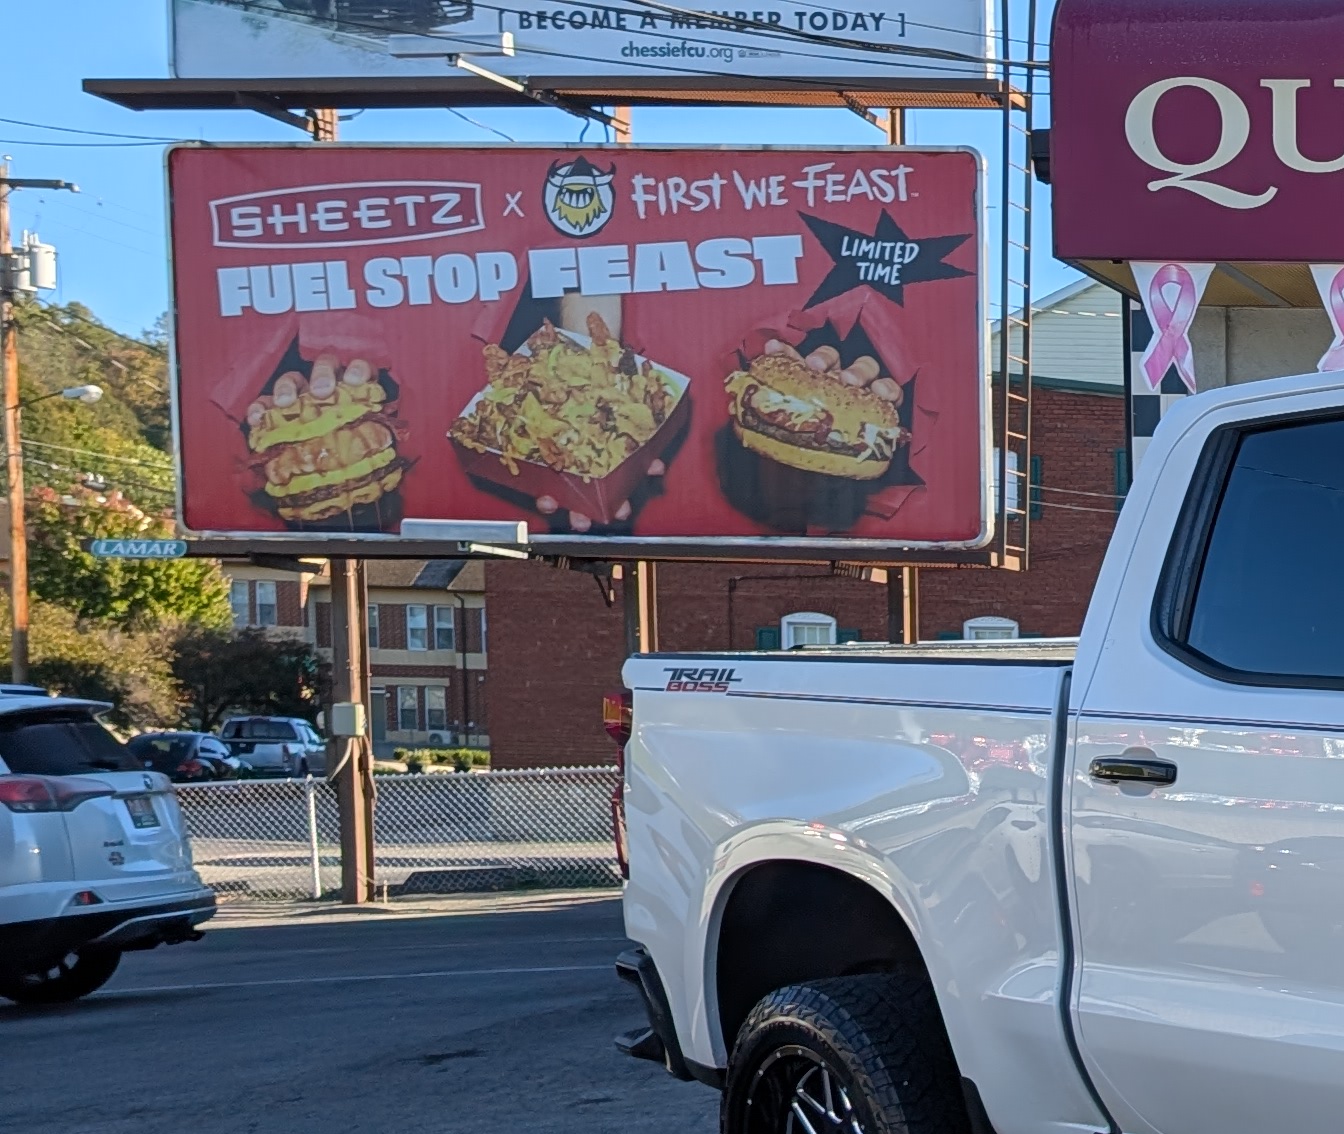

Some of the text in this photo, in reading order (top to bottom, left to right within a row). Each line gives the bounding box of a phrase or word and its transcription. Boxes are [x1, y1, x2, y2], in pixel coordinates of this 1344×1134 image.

[518, 10, 627, 30] BECOME
[639, 11, 658, 29] A
[795, 12, 886, 32] TODAY
[620, 41, 734, 63] chessiefcu.org
[632, 162, 915, 219] FIRST WE FEAST
[230, 193, 464, 237] SHEETZ
[841, 236, 919, 264] LIMITED
[216, 235, 804, 317] FUEL STOP FEAST
[856, 262, 901, 286] TIME
[99, 541, 178, 556] LAMAR
[663, 667, 743, 682] TRAIL
[666, 681, 730, 692] BOSS
